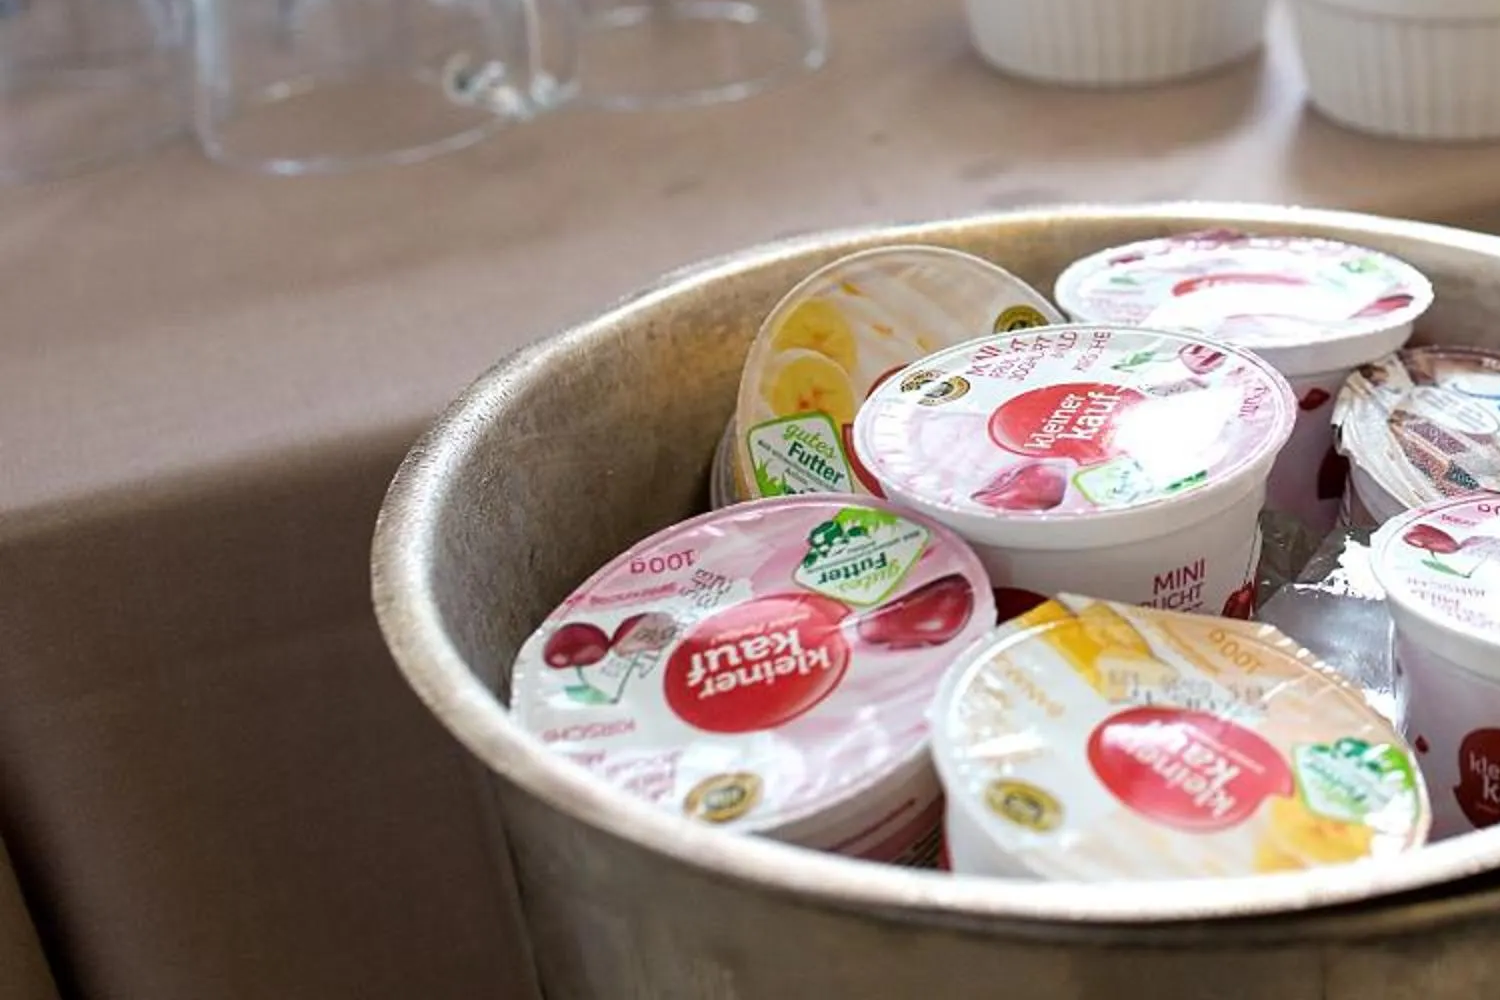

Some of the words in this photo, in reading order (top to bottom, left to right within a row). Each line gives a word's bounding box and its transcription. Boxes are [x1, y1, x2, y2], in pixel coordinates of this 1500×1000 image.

[1023, 392, 1086, 450] kleiner
[1056, 390, 1122, 440] kauf
[782, 423, 836, 460] gutes
[786, 440, 846, 485] Futter
[630, 549, 695, 574] 100g
[818, 551, 888, 584] Futter
[1152, 557, 1205, 596] MINI
[1140, 581, 1205, 611] UCHT
[686, 628, 801, 687] kauf
[697, 646, 832, 699] kleiner
[1208, 626, 1263, 673] 100g
[1104, 730, 1238, 820] kleine
